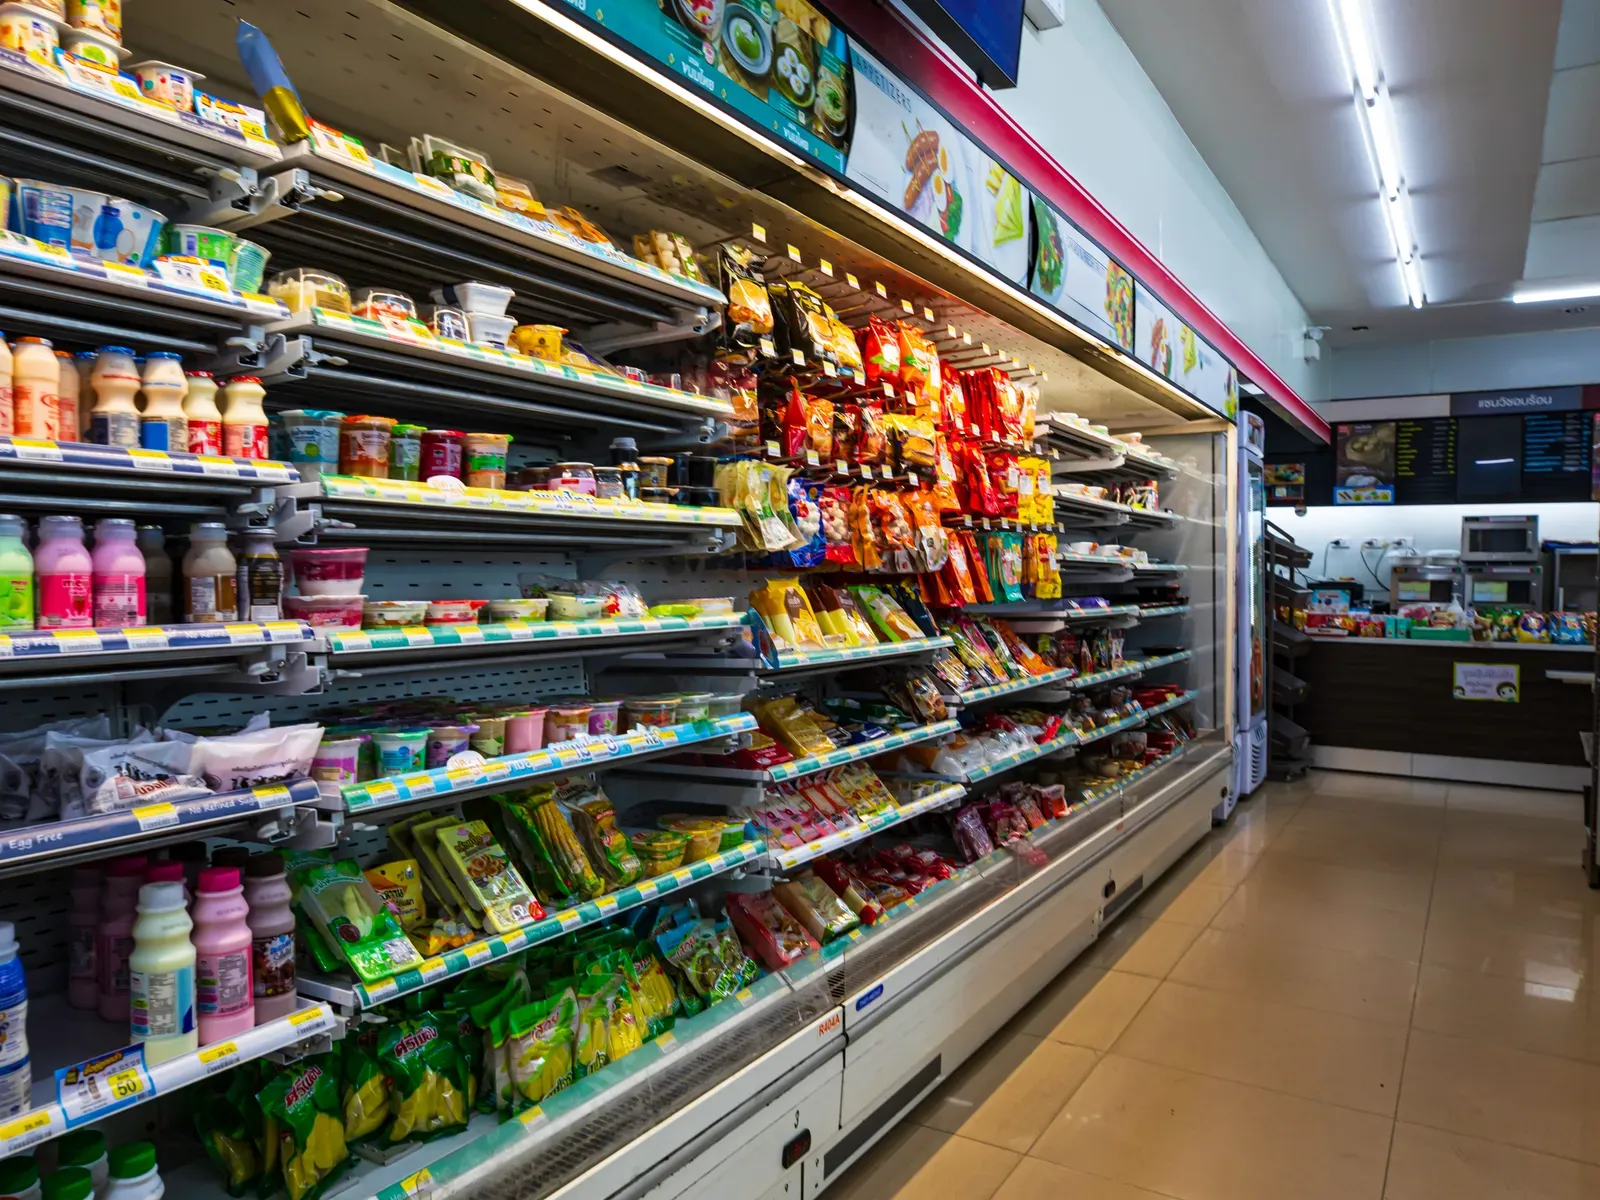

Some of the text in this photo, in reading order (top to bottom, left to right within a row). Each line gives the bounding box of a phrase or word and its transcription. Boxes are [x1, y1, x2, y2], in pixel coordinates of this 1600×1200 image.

[856, 54, 912, 114] APPETIZERS
[188, 807, 202, 816] No
[203, 799, 236, 813] Refined
[8, 832, 64, 851] Egg Free
[818, 1013, 841, 1037] R404A
[117, 1079, 137, 1097] 50
